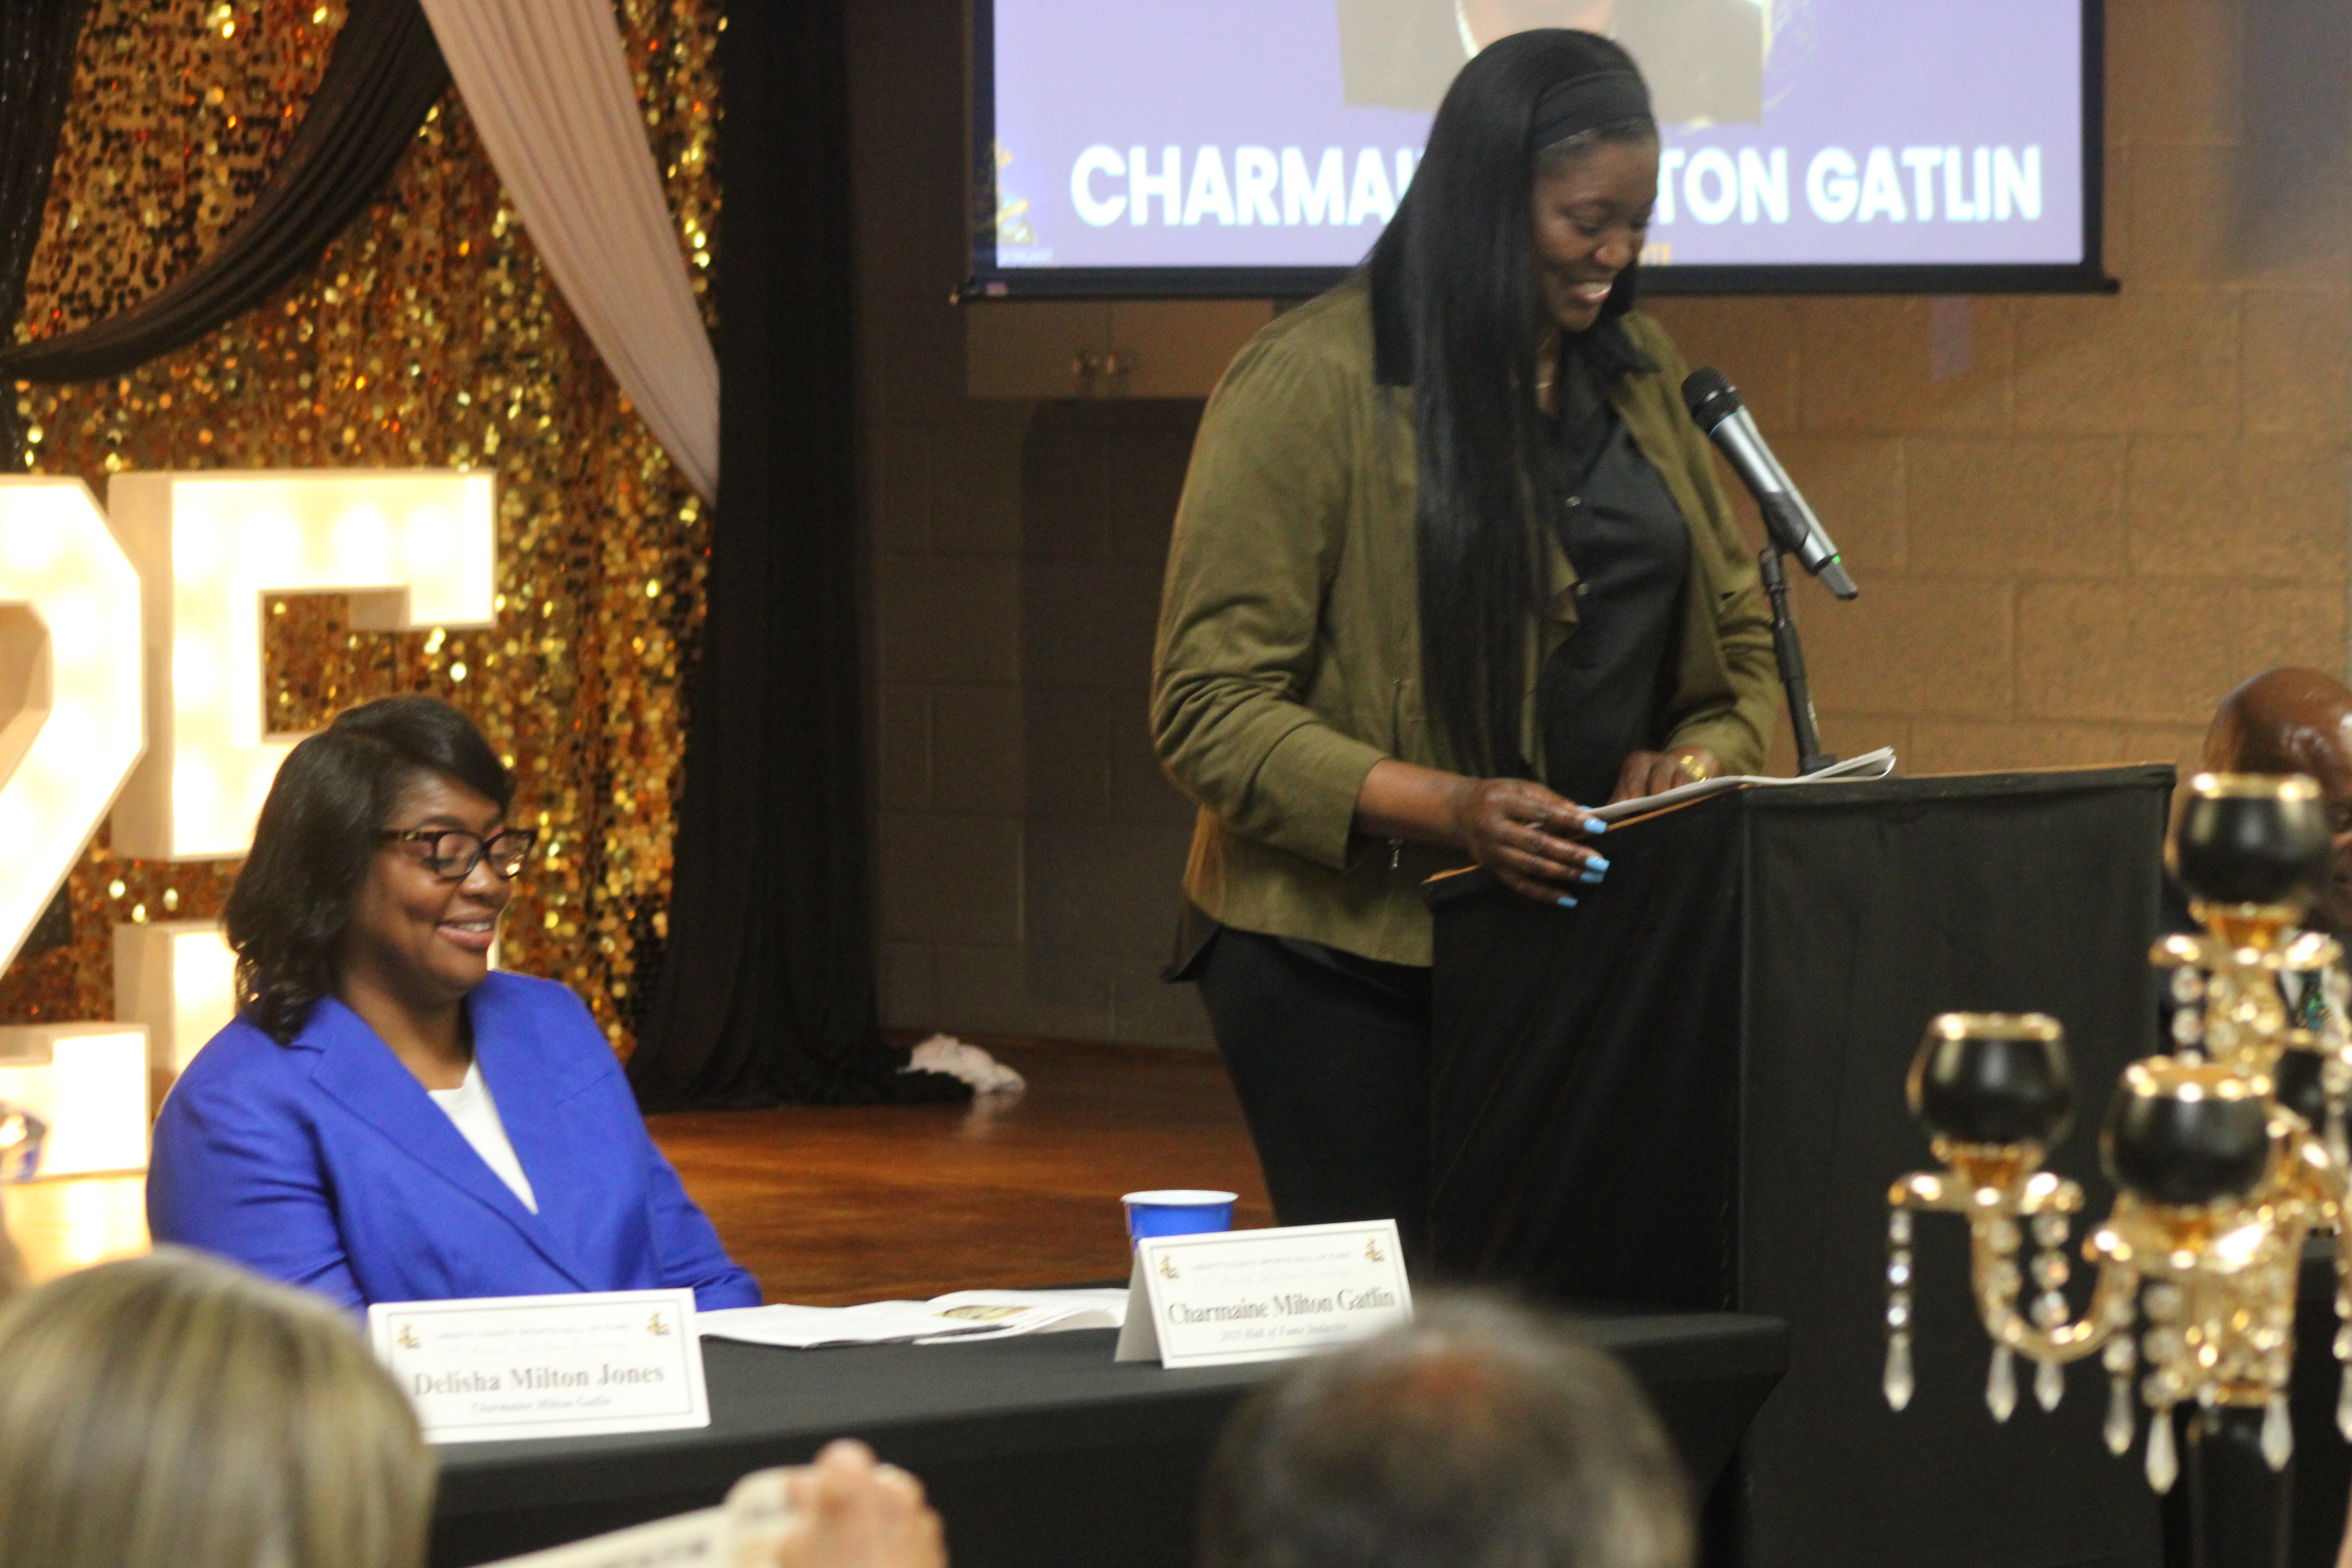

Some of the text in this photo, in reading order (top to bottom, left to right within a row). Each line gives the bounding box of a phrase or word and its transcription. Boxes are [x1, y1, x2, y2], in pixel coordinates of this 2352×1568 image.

[1070, 144, 2042, 226] CHARMAI TON GATLIN
[1168, 1287, 1394, 1325] Charmaine Milton Gatlin
[414, 1363, 665, 1396] Delisha Milton Jones
